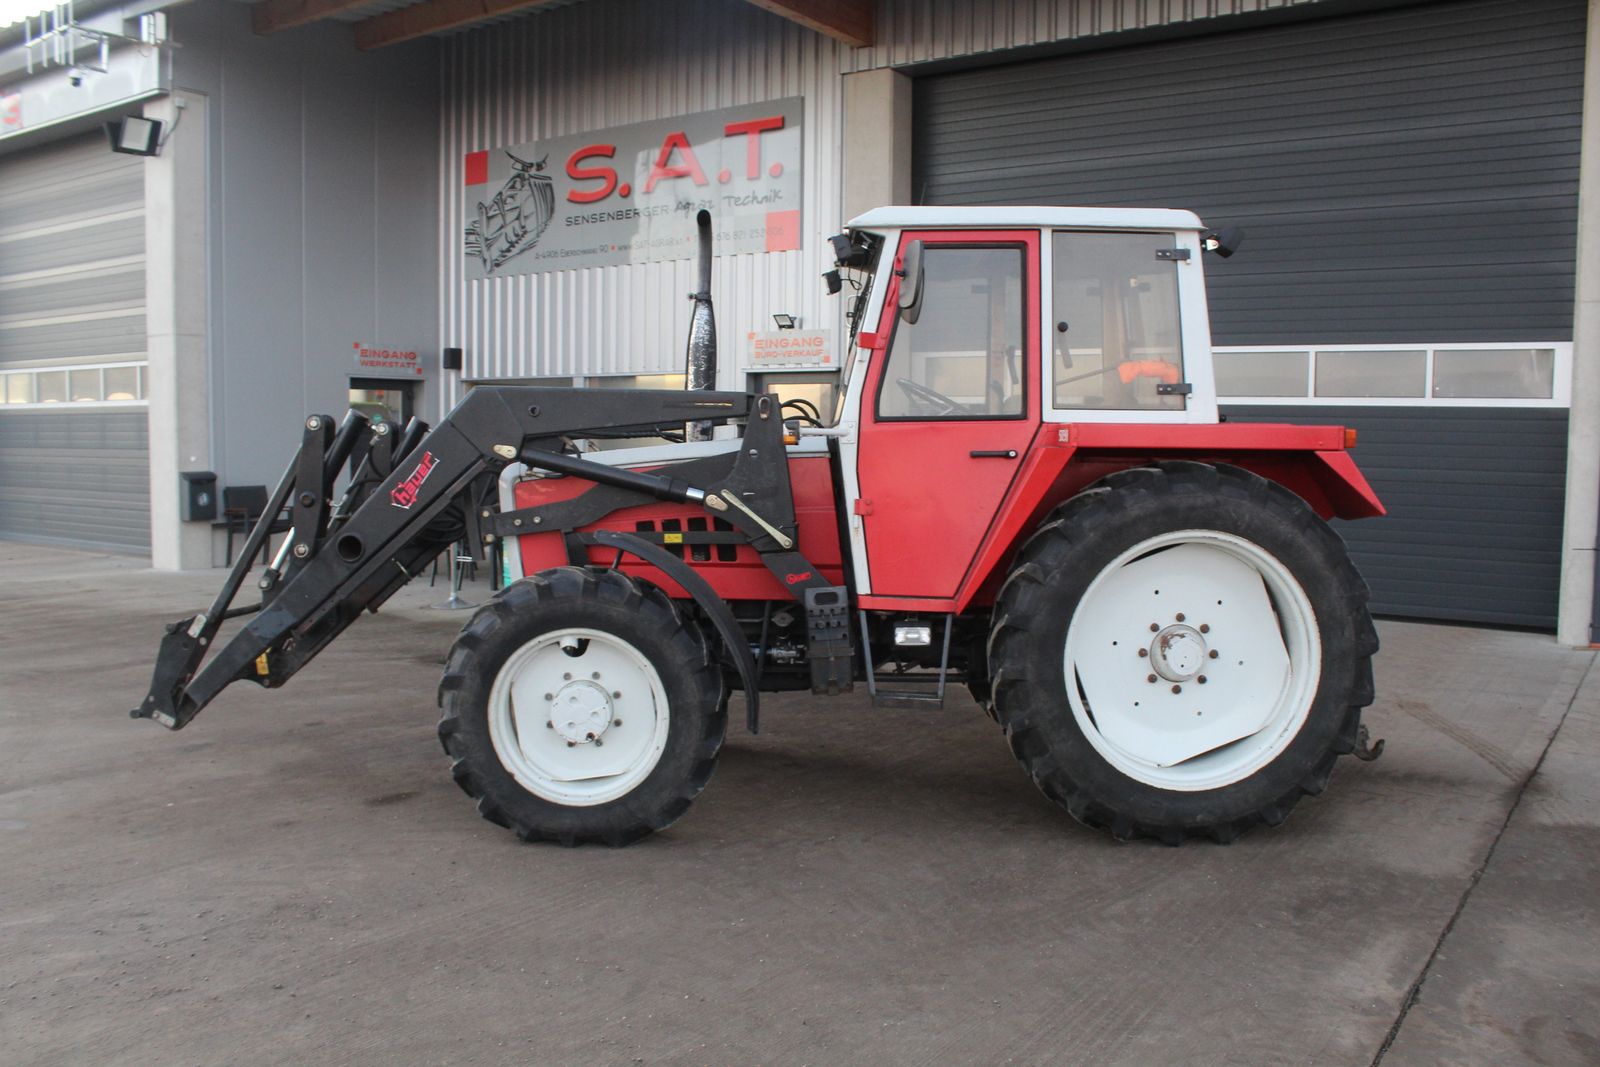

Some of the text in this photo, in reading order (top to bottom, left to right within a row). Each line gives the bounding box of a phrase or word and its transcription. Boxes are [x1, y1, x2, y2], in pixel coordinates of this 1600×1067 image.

[565, 115, 785, 204] S.A.T.
[565, 204, 670, 227] SENSENBERGER
[723, 188, 783, 208] Technik
[360, 349, 416, 360] EINGANG
[755, 337, 824, 349] EINGANG
[360, 360, 416, 368] WERKSTATT
[393, 451, 433, 506] hauer
